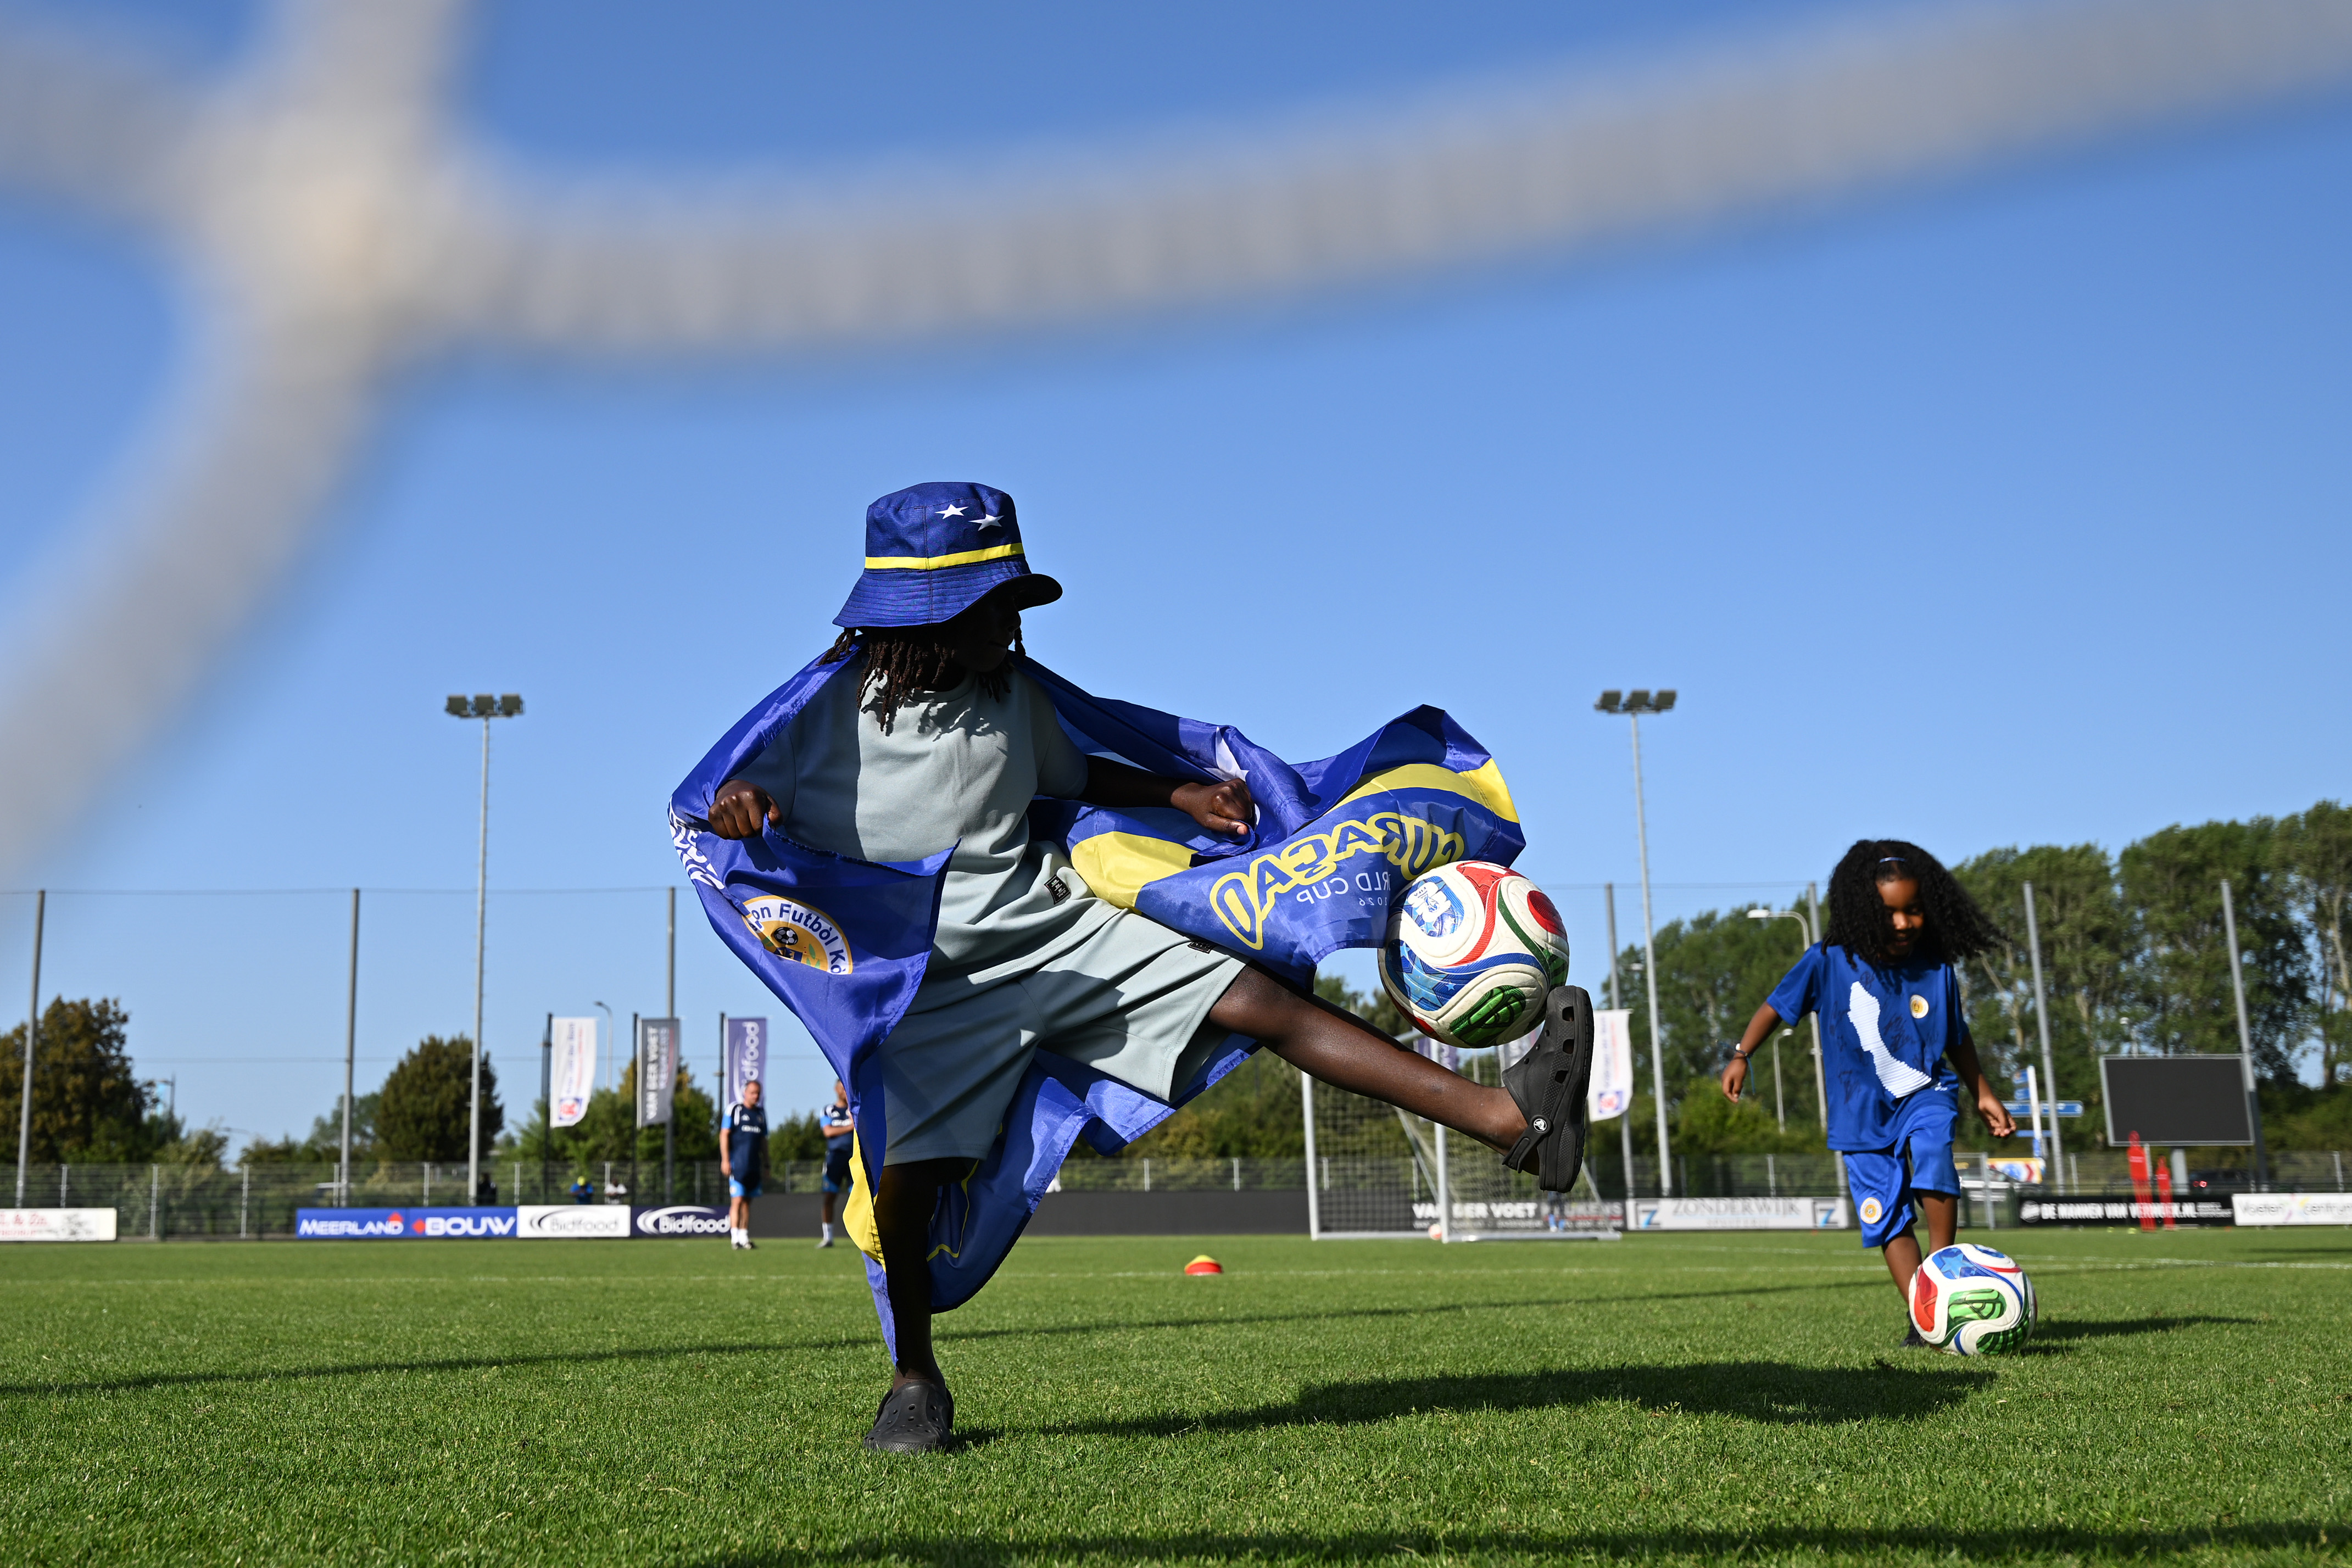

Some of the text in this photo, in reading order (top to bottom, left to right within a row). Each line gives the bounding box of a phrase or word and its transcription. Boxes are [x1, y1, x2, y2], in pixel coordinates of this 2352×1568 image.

[779, 903, 839, 946] Futbòl
[742, 1021, 760, 1084] dfood
[1490, 1203, 1538, 1219] VOET
[299, 1219, 404, 1235] MEERLAND
[425, 1217, 516, 1236] BOUW
[551, 1215, 620, 1232] Bidfood
[659, 1214, 731, 1234] Bidfood
